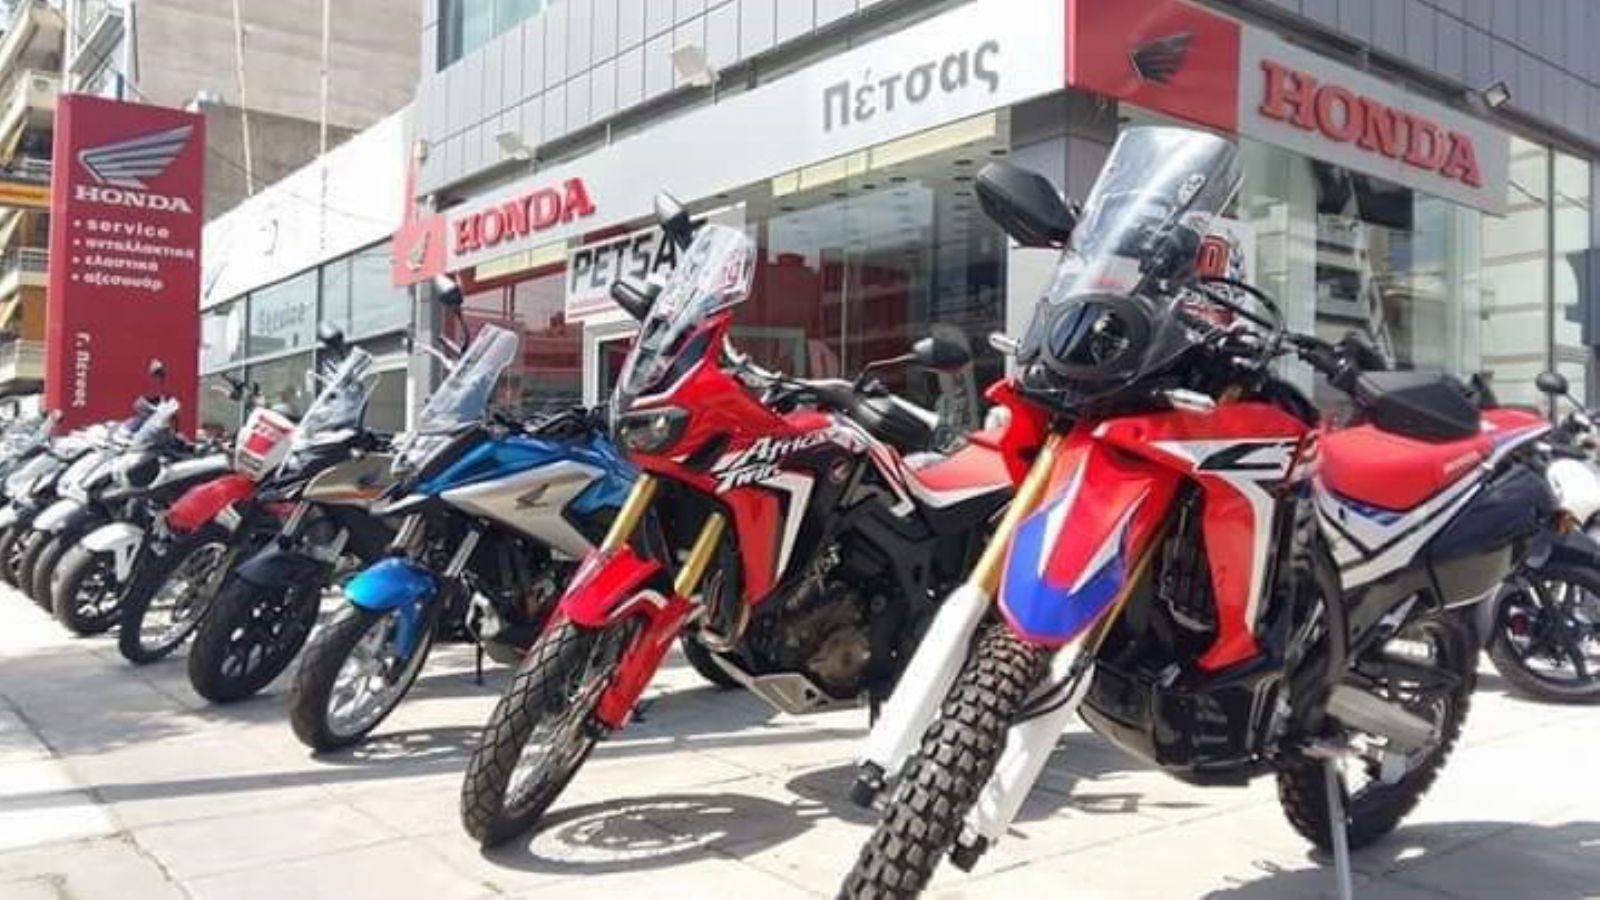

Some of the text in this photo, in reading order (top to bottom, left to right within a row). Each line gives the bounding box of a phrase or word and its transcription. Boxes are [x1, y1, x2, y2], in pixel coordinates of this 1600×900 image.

[822, 38, 1002, 134] Πέτσας
[1258, 58, 1484, 189] HONDA
[74, 184, 193, 214] HONDA
[86, 219, 170, 239] service
[453, 176, 597, 256] HONDA
[571, 217, 708, 295] PETSA
